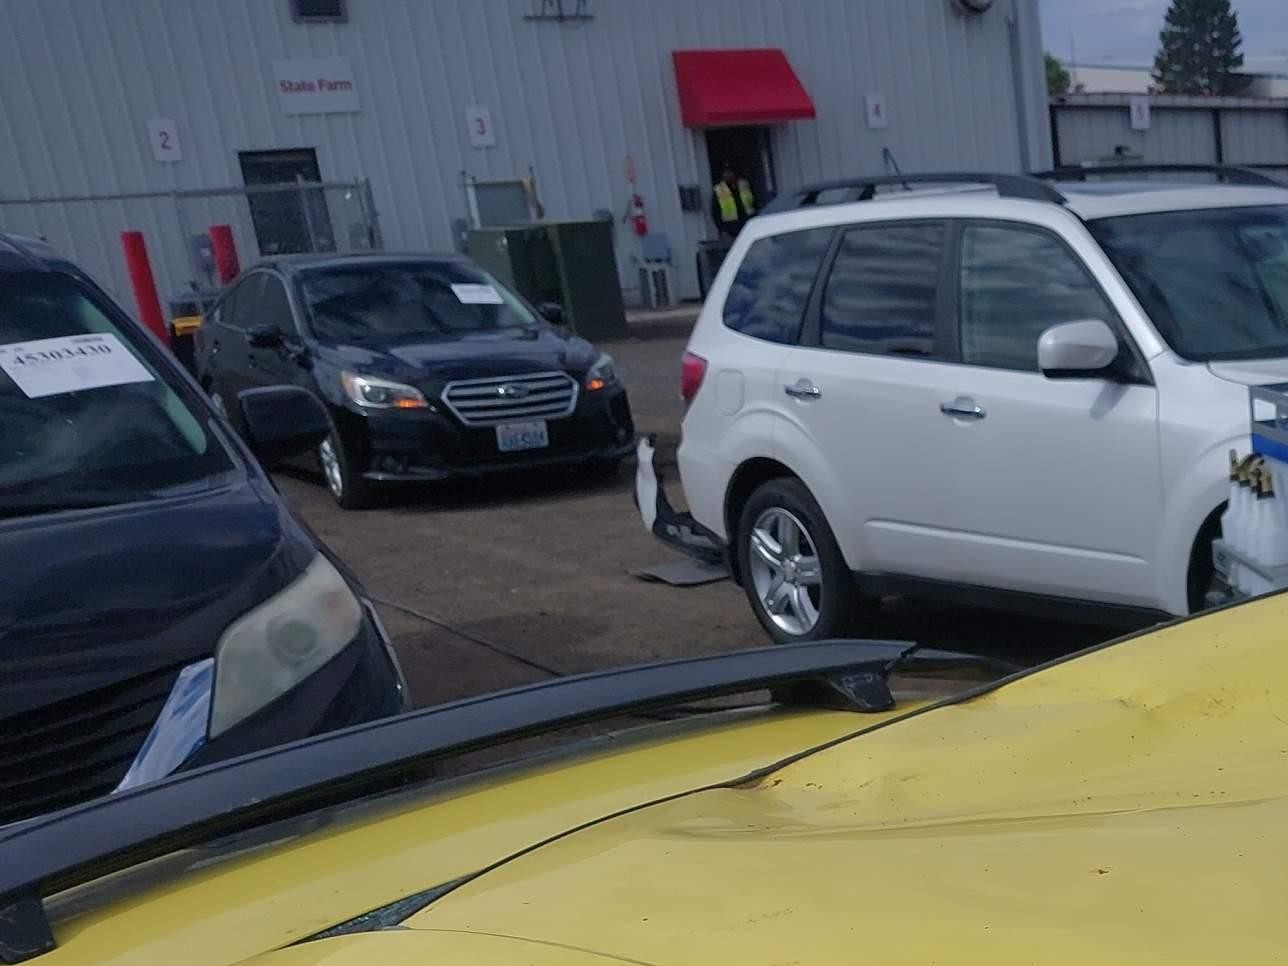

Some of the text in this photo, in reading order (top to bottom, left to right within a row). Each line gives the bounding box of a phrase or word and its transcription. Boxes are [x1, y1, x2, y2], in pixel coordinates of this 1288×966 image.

[279, 78, 352, 93] State Farm
[475, 117, 486, 135] 3
[159, 130, 172, 150] 2
[13, 344, 112, 365] 45303430
